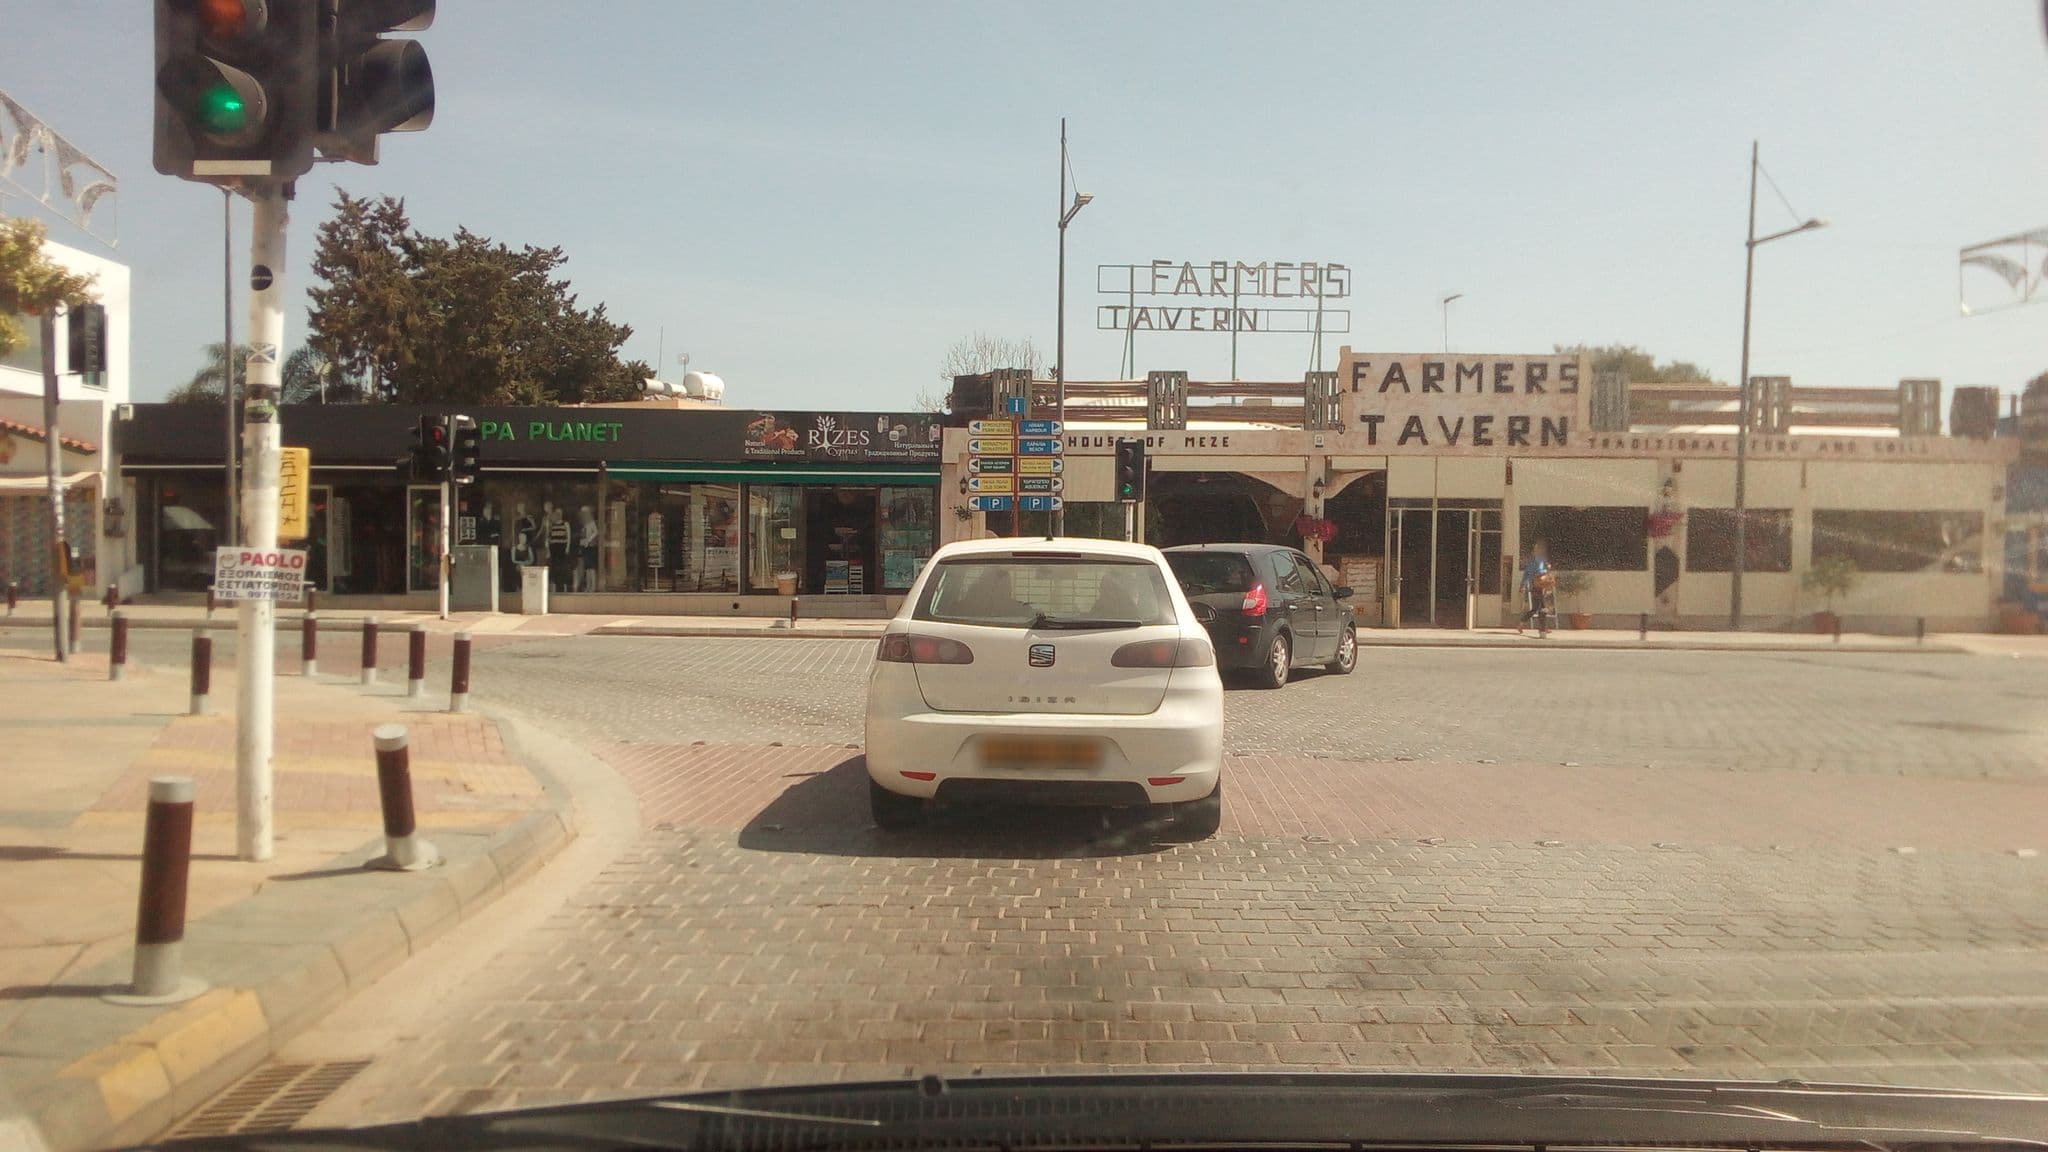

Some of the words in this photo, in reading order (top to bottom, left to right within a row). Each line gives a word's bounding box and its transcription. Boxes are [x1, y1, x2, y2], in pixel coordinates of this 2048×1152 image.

[1151, 259, 1345, 298] FARMERS
[1105, 305, 1258, 331] TAVERN
[1352, 361, 1579, 394] FARMERS
[528, 421, 623, 442] PLANET
[808, 423, 871, 448] RIZES
[1146, 436, 1165, 448] OF
[1184, 436, 1229, 448] MEZE
[1360, 414, 1569, 447] TAVERN
[992, 498, 1000, 509] P
[1032, 498, 1041, 509] P
[240, 551, 304, 569] PAOLO
